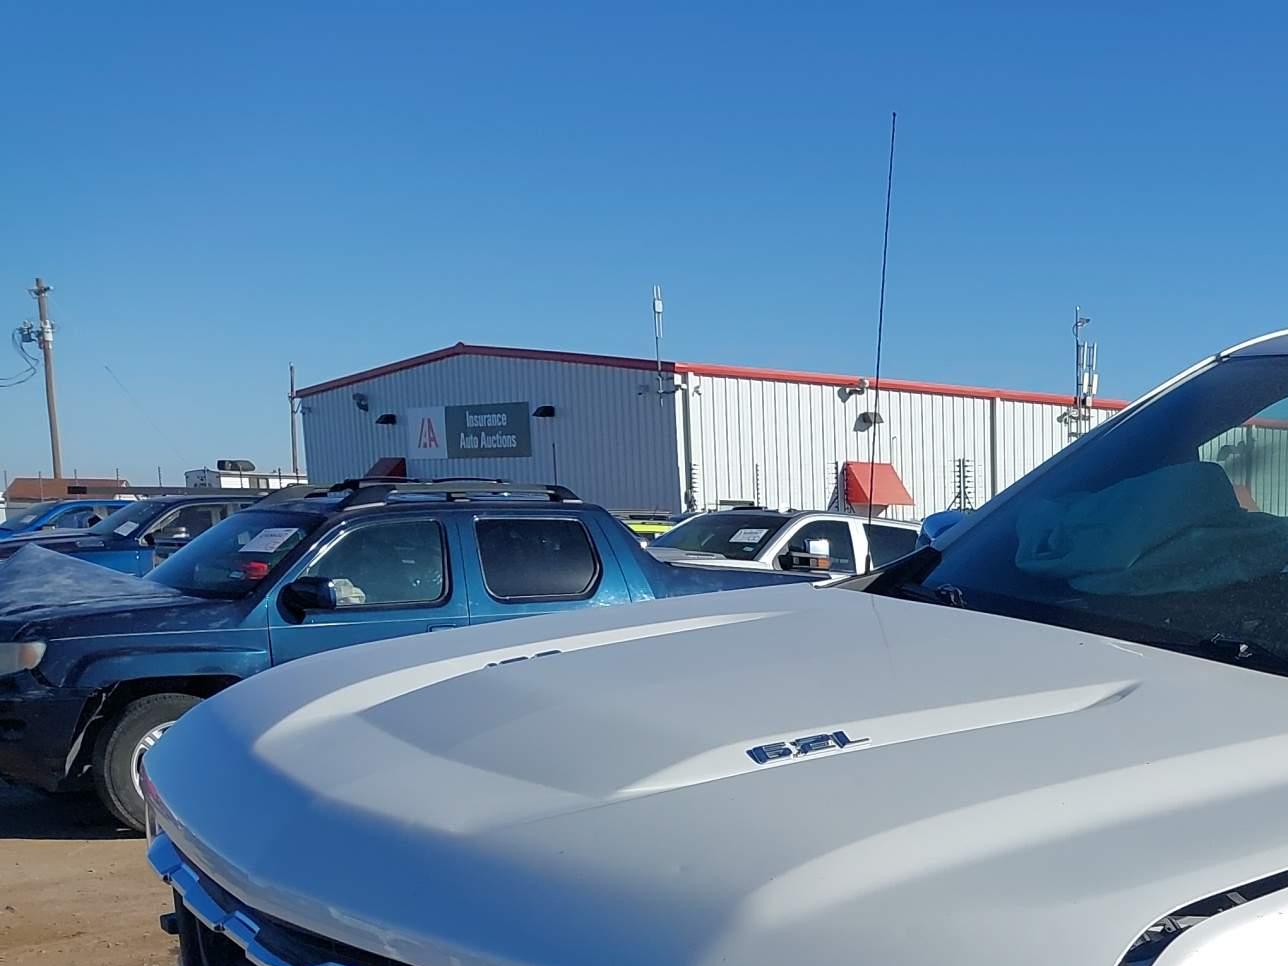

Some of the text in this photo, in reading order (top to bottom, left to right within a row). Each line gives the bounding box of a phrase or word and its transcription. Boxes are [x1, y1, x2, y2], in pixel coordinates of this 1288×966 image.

[465, 410, 508, 428] Insurance
[459, 430, 517, 449] Auto Auctions
